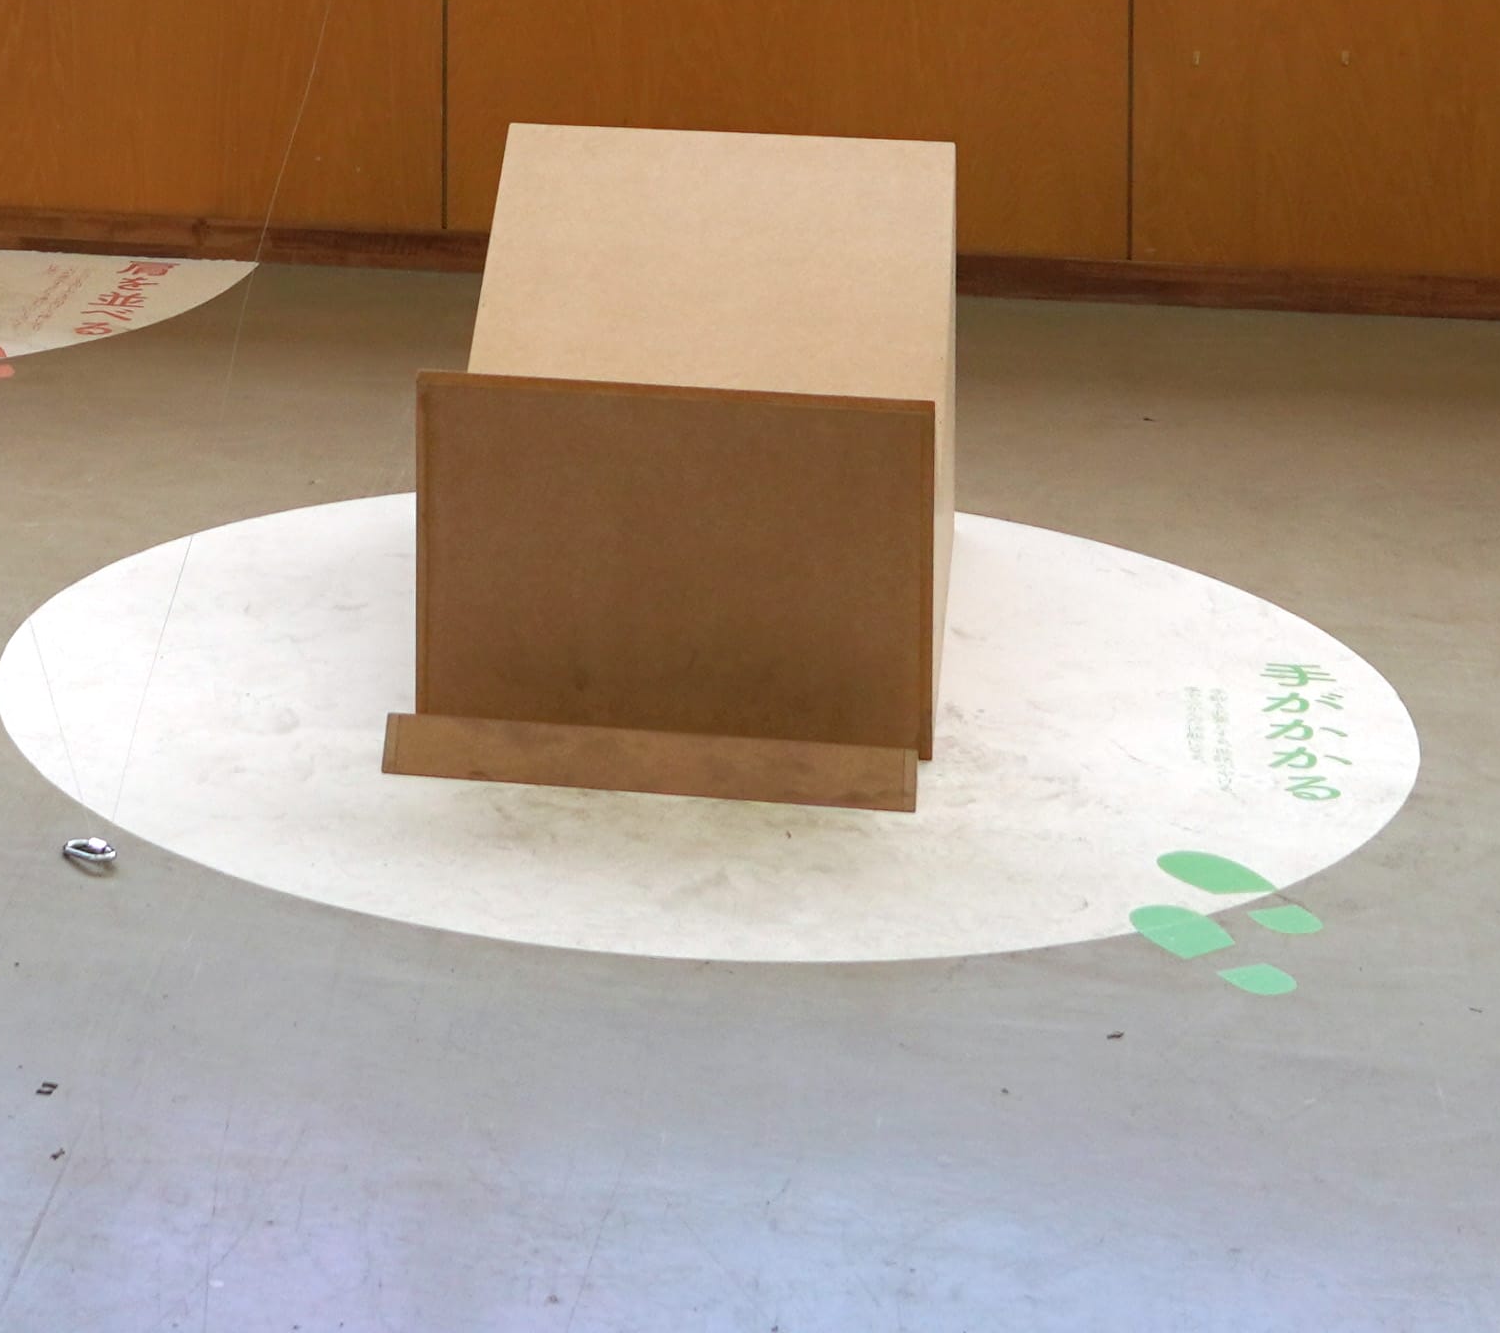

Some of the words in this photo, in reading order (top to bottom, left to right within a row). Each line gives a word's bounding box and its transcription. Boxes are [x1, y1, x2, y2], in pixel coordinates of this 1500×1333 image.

[1259, 661, 1353, 802] 手がかかる
